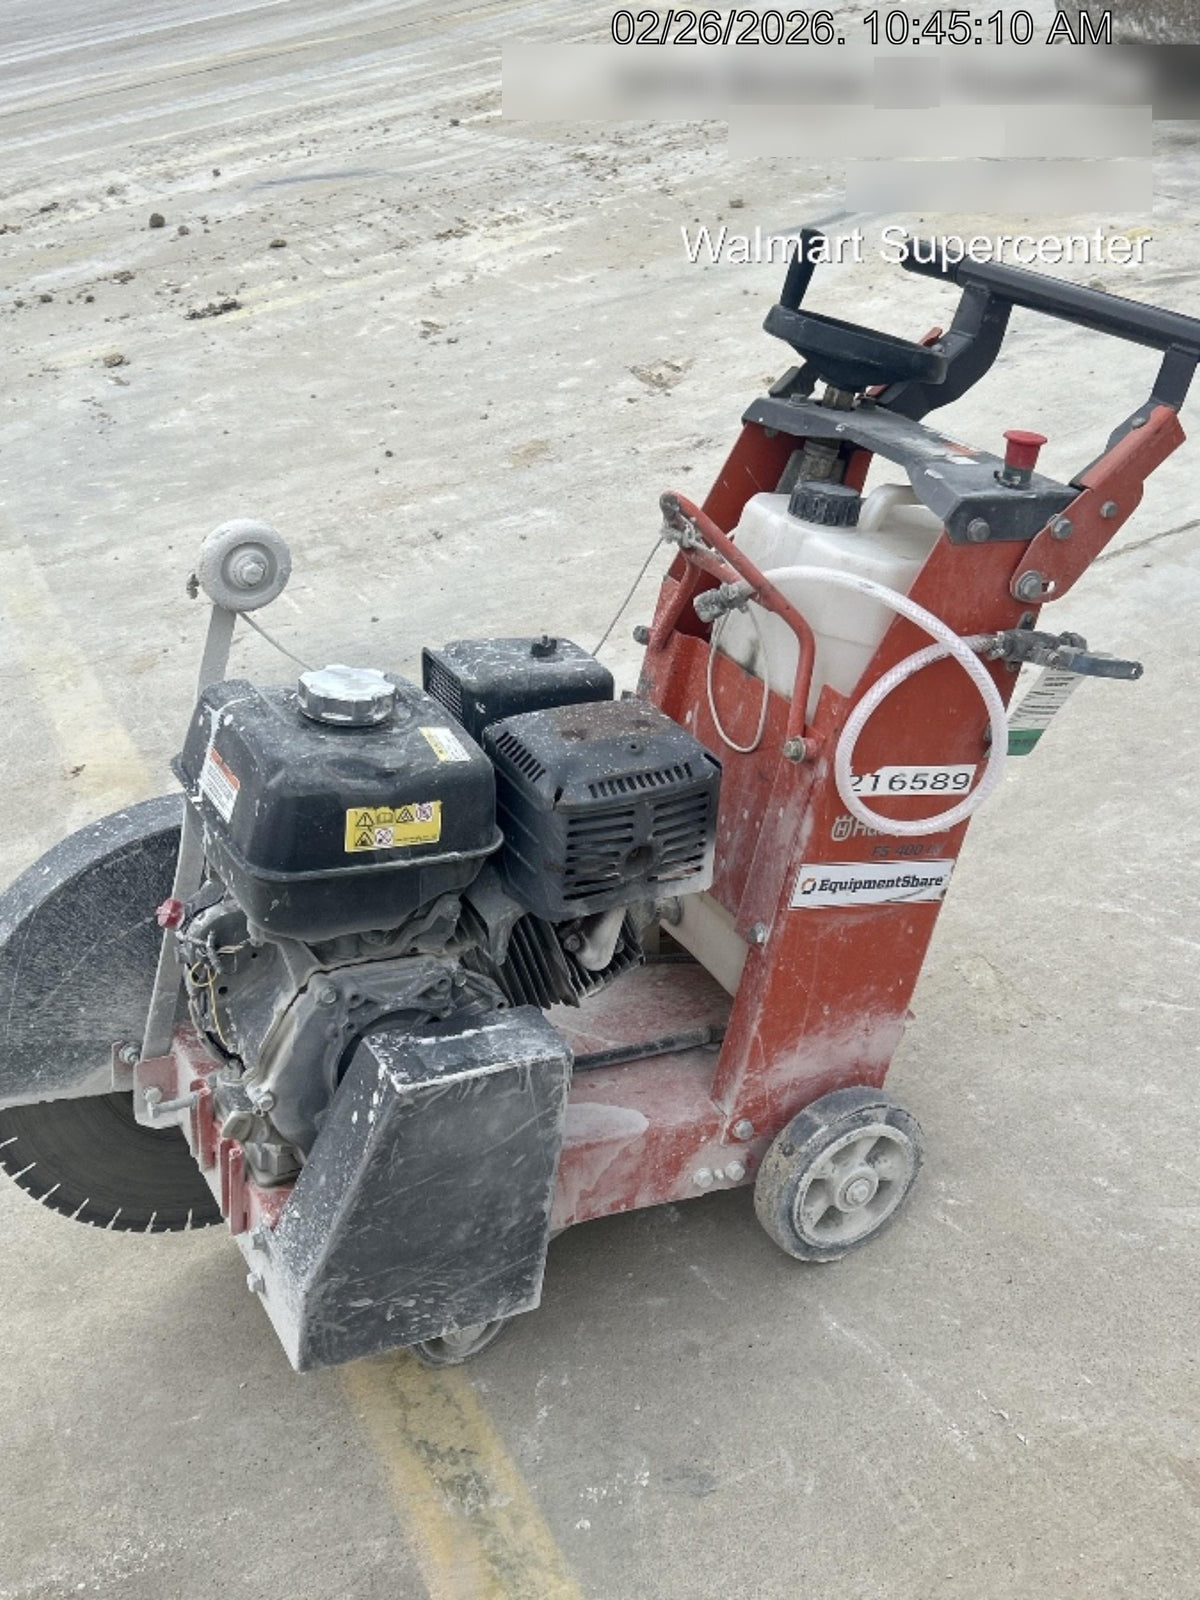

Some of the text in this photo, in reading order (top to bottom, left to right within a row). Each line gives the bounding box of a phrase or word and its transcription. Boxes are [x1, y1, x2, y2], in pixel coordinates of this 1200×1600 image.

[850, 772, 971, 792] 216589
[872, 845, 890, 857] FS
[896, 843, 923, 856] 400
[818, 875, 944, 893] EquipmentShare
